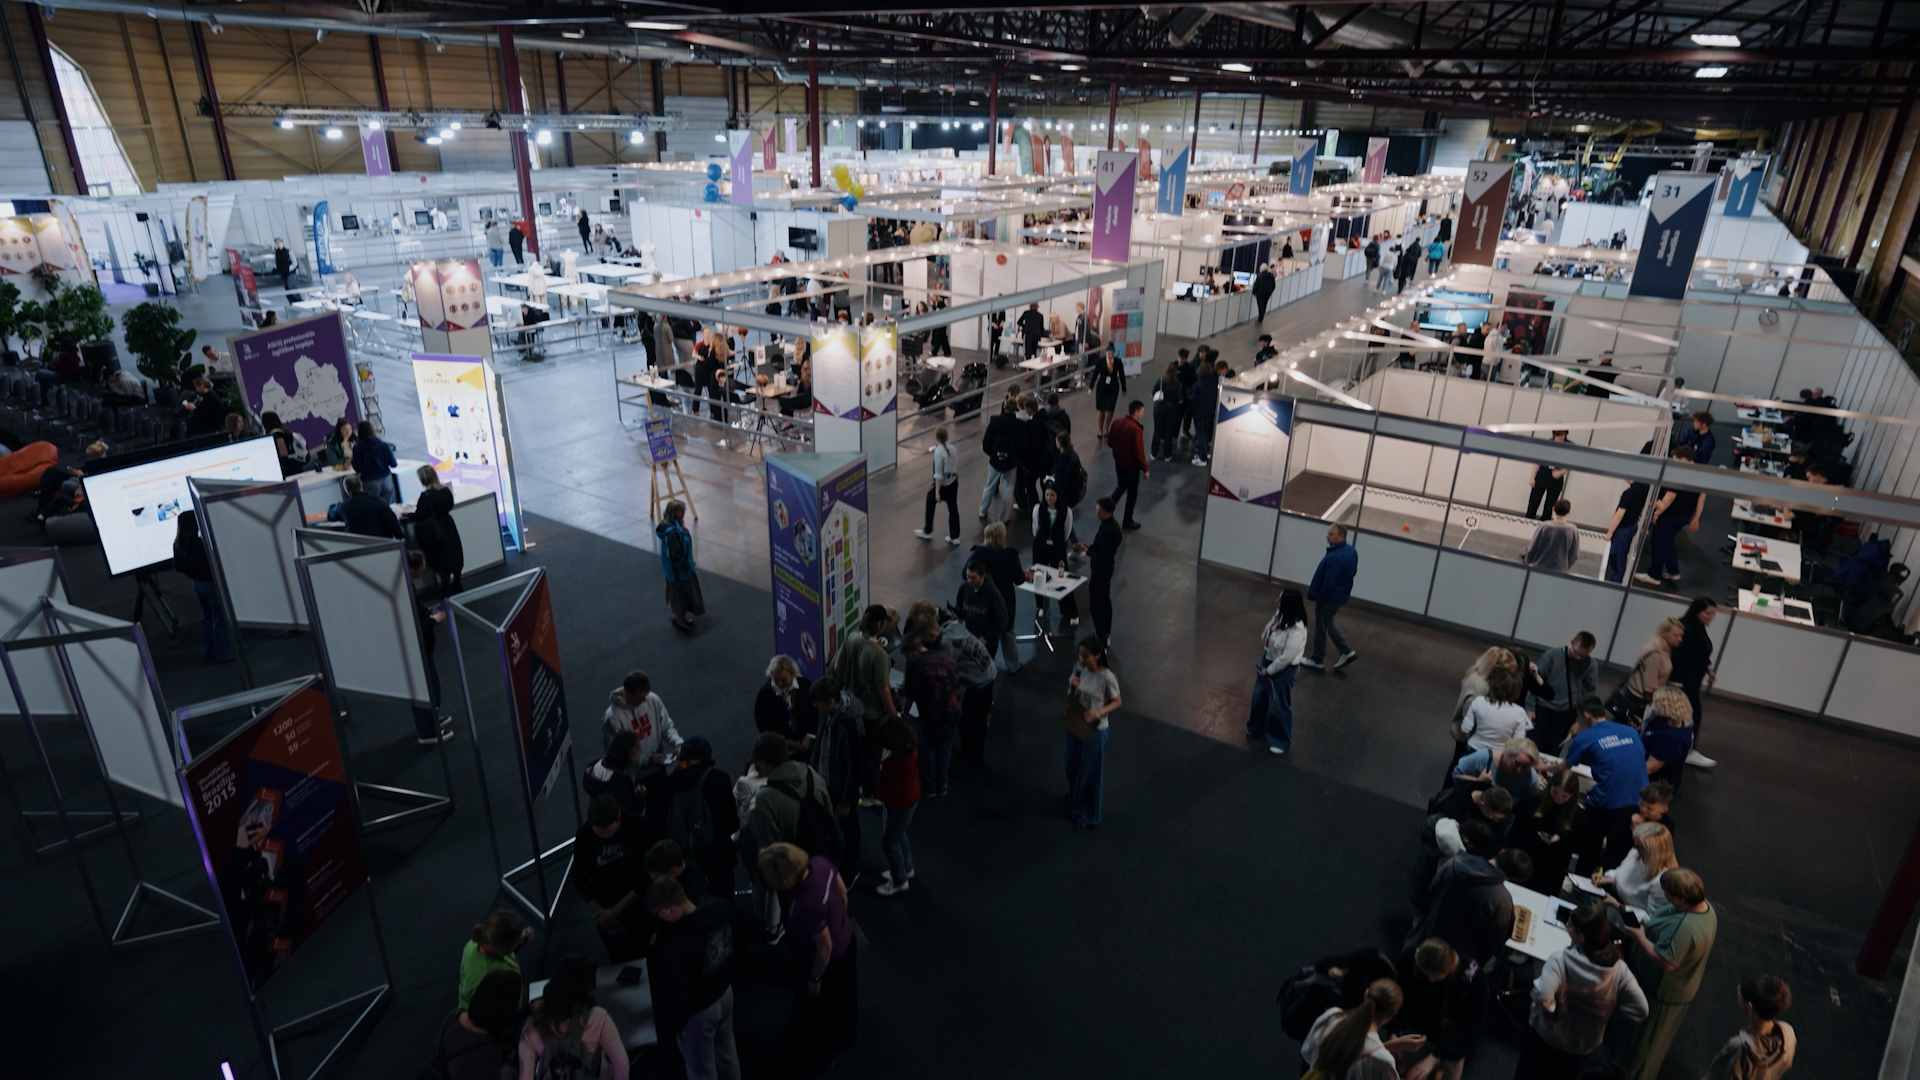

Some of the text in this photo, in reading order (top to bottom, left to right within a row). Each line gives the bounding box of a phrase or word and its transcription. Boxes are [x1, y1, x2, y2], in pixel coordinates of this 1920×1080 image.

[1102, 161, 1115, 173] 41
[1473, 171, 1488, 182] 52
[1662, 185, 1681, 198] 31
[1657, 229, 1671, 259] Mobilā
[1666, 229, 1681, 267] robotika
[267, 330, 316, 350] Atklāj profesionālās
[272, 345, 295, 357] izglītības
[294, 339, 315, 350] iespējas
[273, 717, 293, 737] 1200
[285, 729, 296, 743] 50
[288, 741, 299, 755] 59
[202, 771, 237, 803] Brazīlija
[205, 782, 237, 816] 2015
